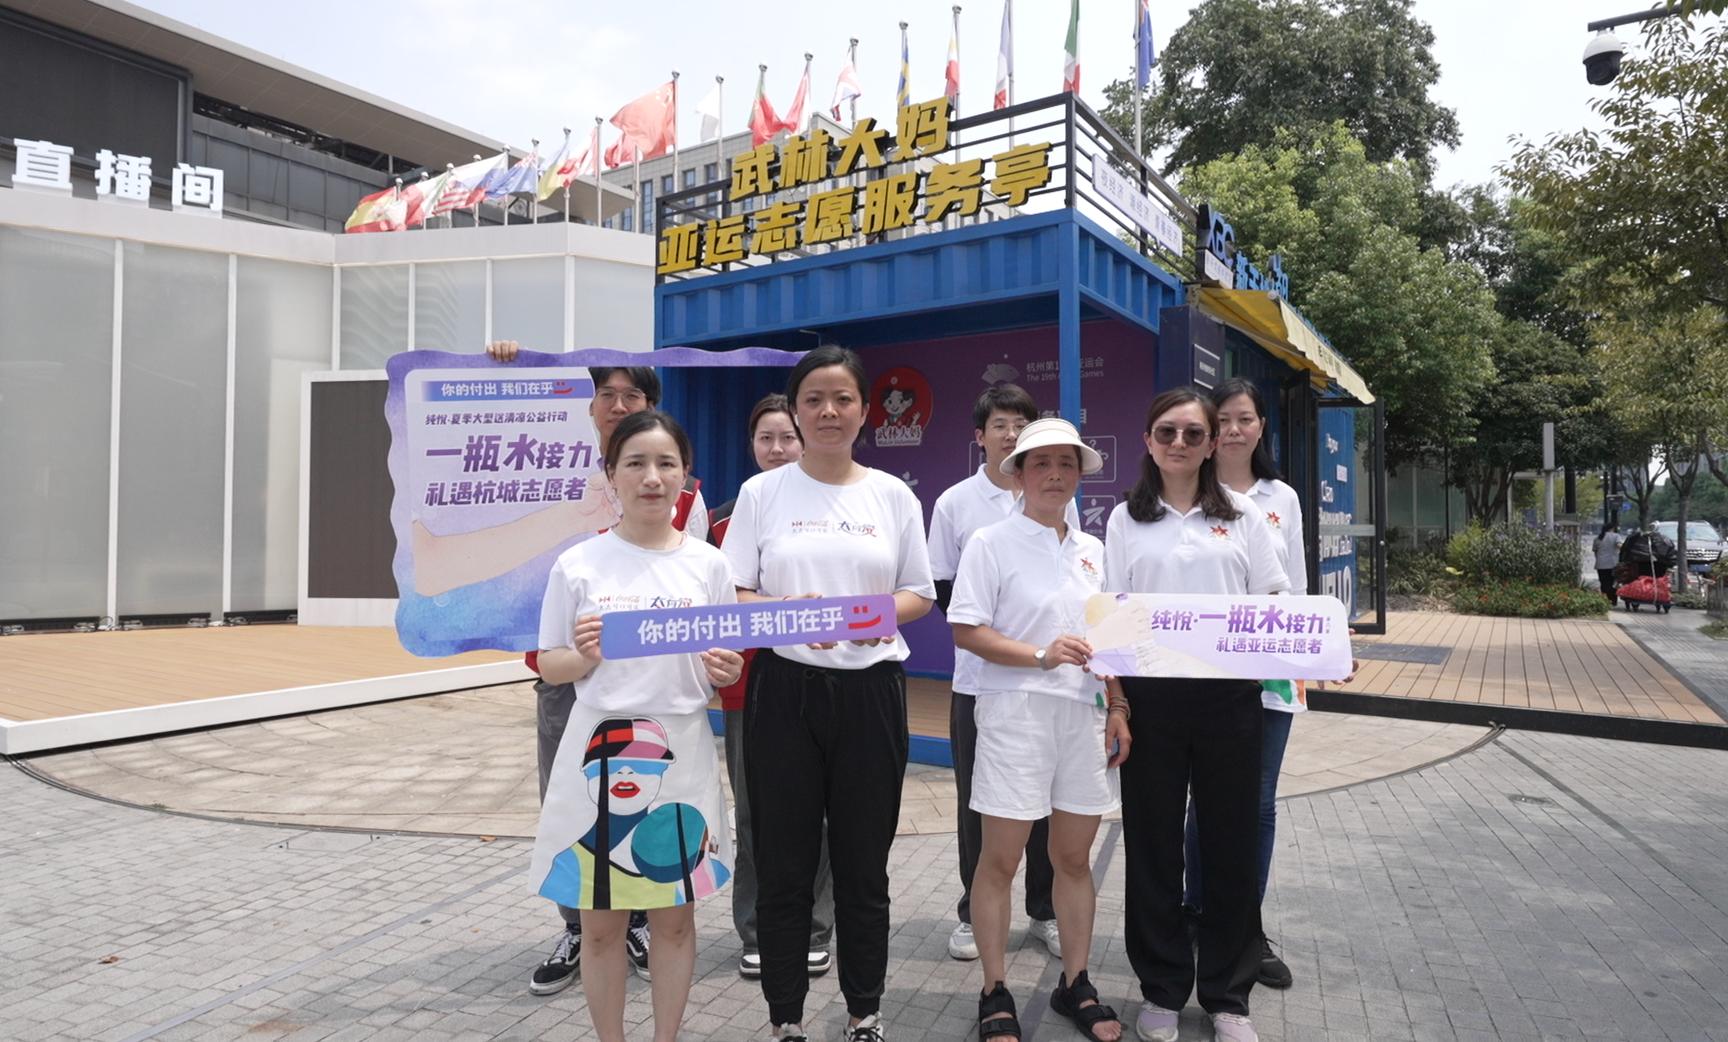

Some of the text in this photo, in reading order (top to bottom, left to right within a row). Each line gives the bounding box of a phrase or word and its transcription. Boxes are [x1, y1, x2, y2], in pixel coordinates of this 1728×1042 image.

[729, 97, 952, 201] 武林大妈
[12, 137, 224, 211] 直播间
[657, 142, 1052, 275] 亚运志愿服务亭
[441, 381, 554, 397] 你的付出 我们在乎
[426, 433, 593, 473] 一瓶水接力
[425, 477, 587, 507] 礼遇杭城志愿者
[637, 605, 844, 646] 你的付出 我们在乎
[1151, 604, 1324, 634] 纯悦·一瓶水接力
[1216, 637, 1323, 654] 礼遇亚运志愿者
